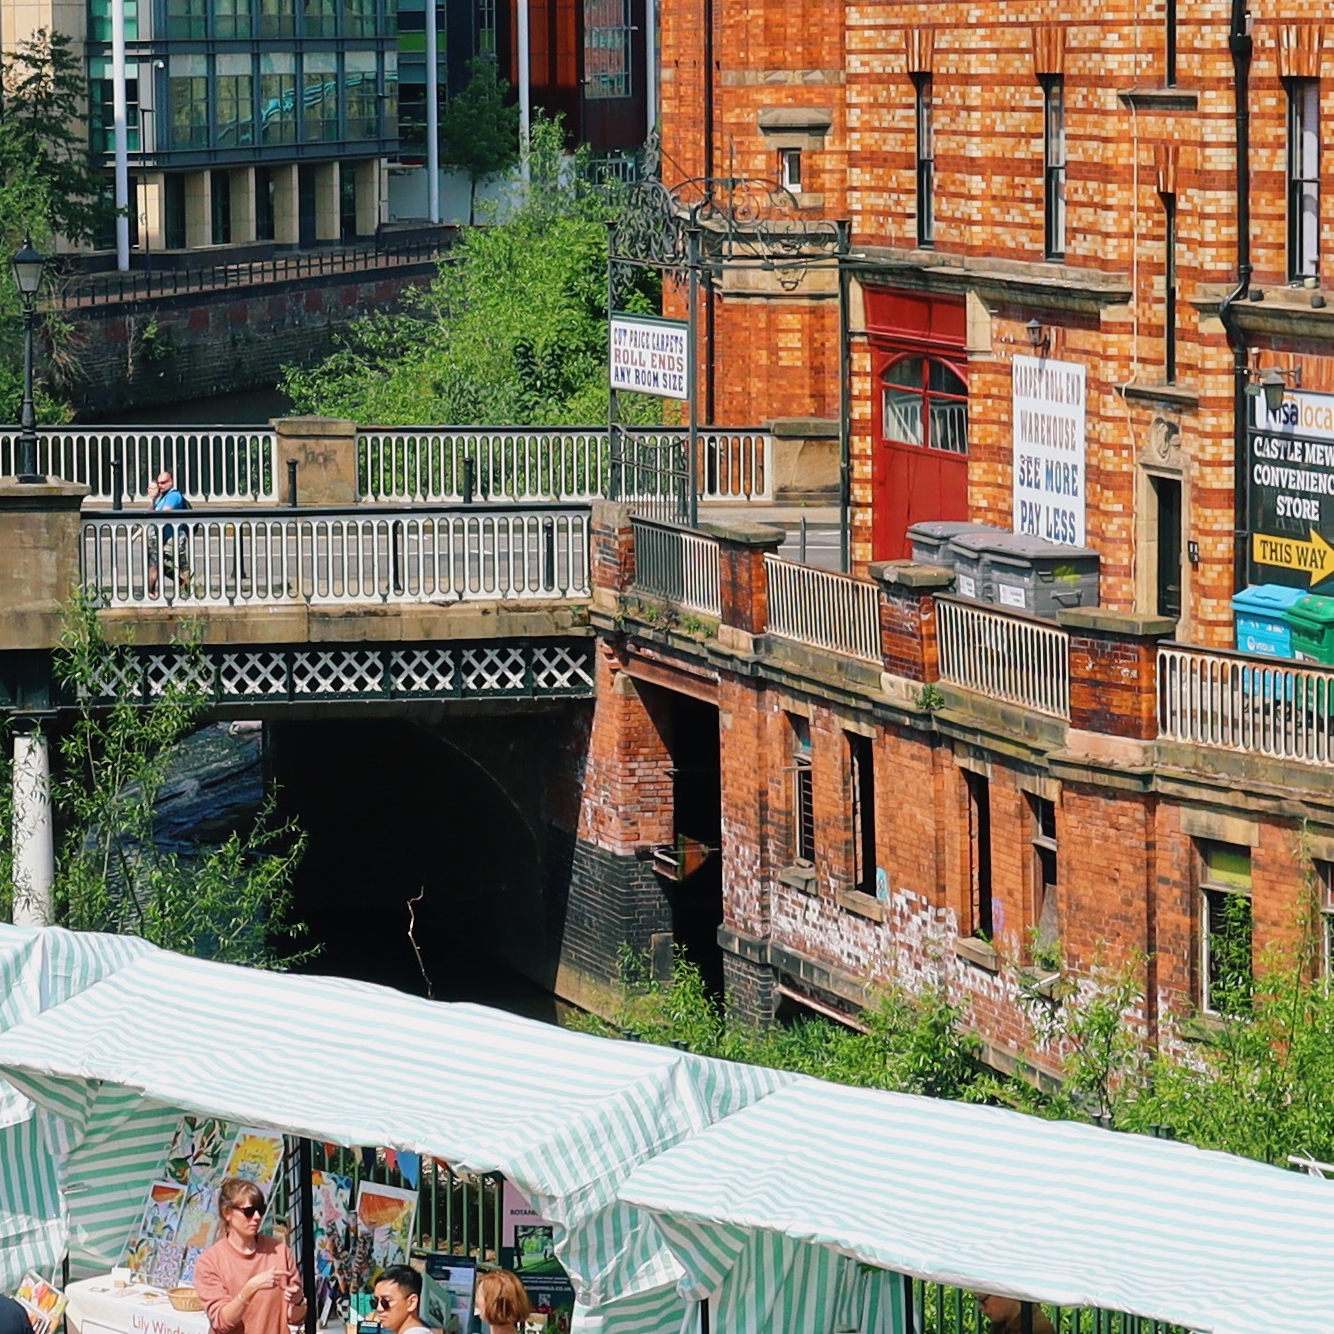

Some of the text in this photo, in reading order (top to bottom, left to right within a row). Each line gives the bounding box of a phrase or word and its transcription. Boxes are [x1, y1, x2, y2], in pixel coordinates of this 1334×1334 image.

[613, 327, 683, 355] CUT PRICE CARPETS
[614, 347, 684, 373] ROLL ENDS
[614, 365, 684, 392] ANY ROOM SIZE
[1045, 368, 1064, 404] ROLL
[1066, 372, 1081, 406] END
[1020, 409, 1076, 452] WAREHOUSE
[1253, 436, 1303, 463] CASTLE
[1019, 453, 1078, 497] SEE MORE
[1020, 499, 1076, 545] PAY LESS
[1276, 494, 1320, 522] STORE
[1259, 539, 1327, 570] THIS WAY
[132, 1314, 149, 1334] Lily
